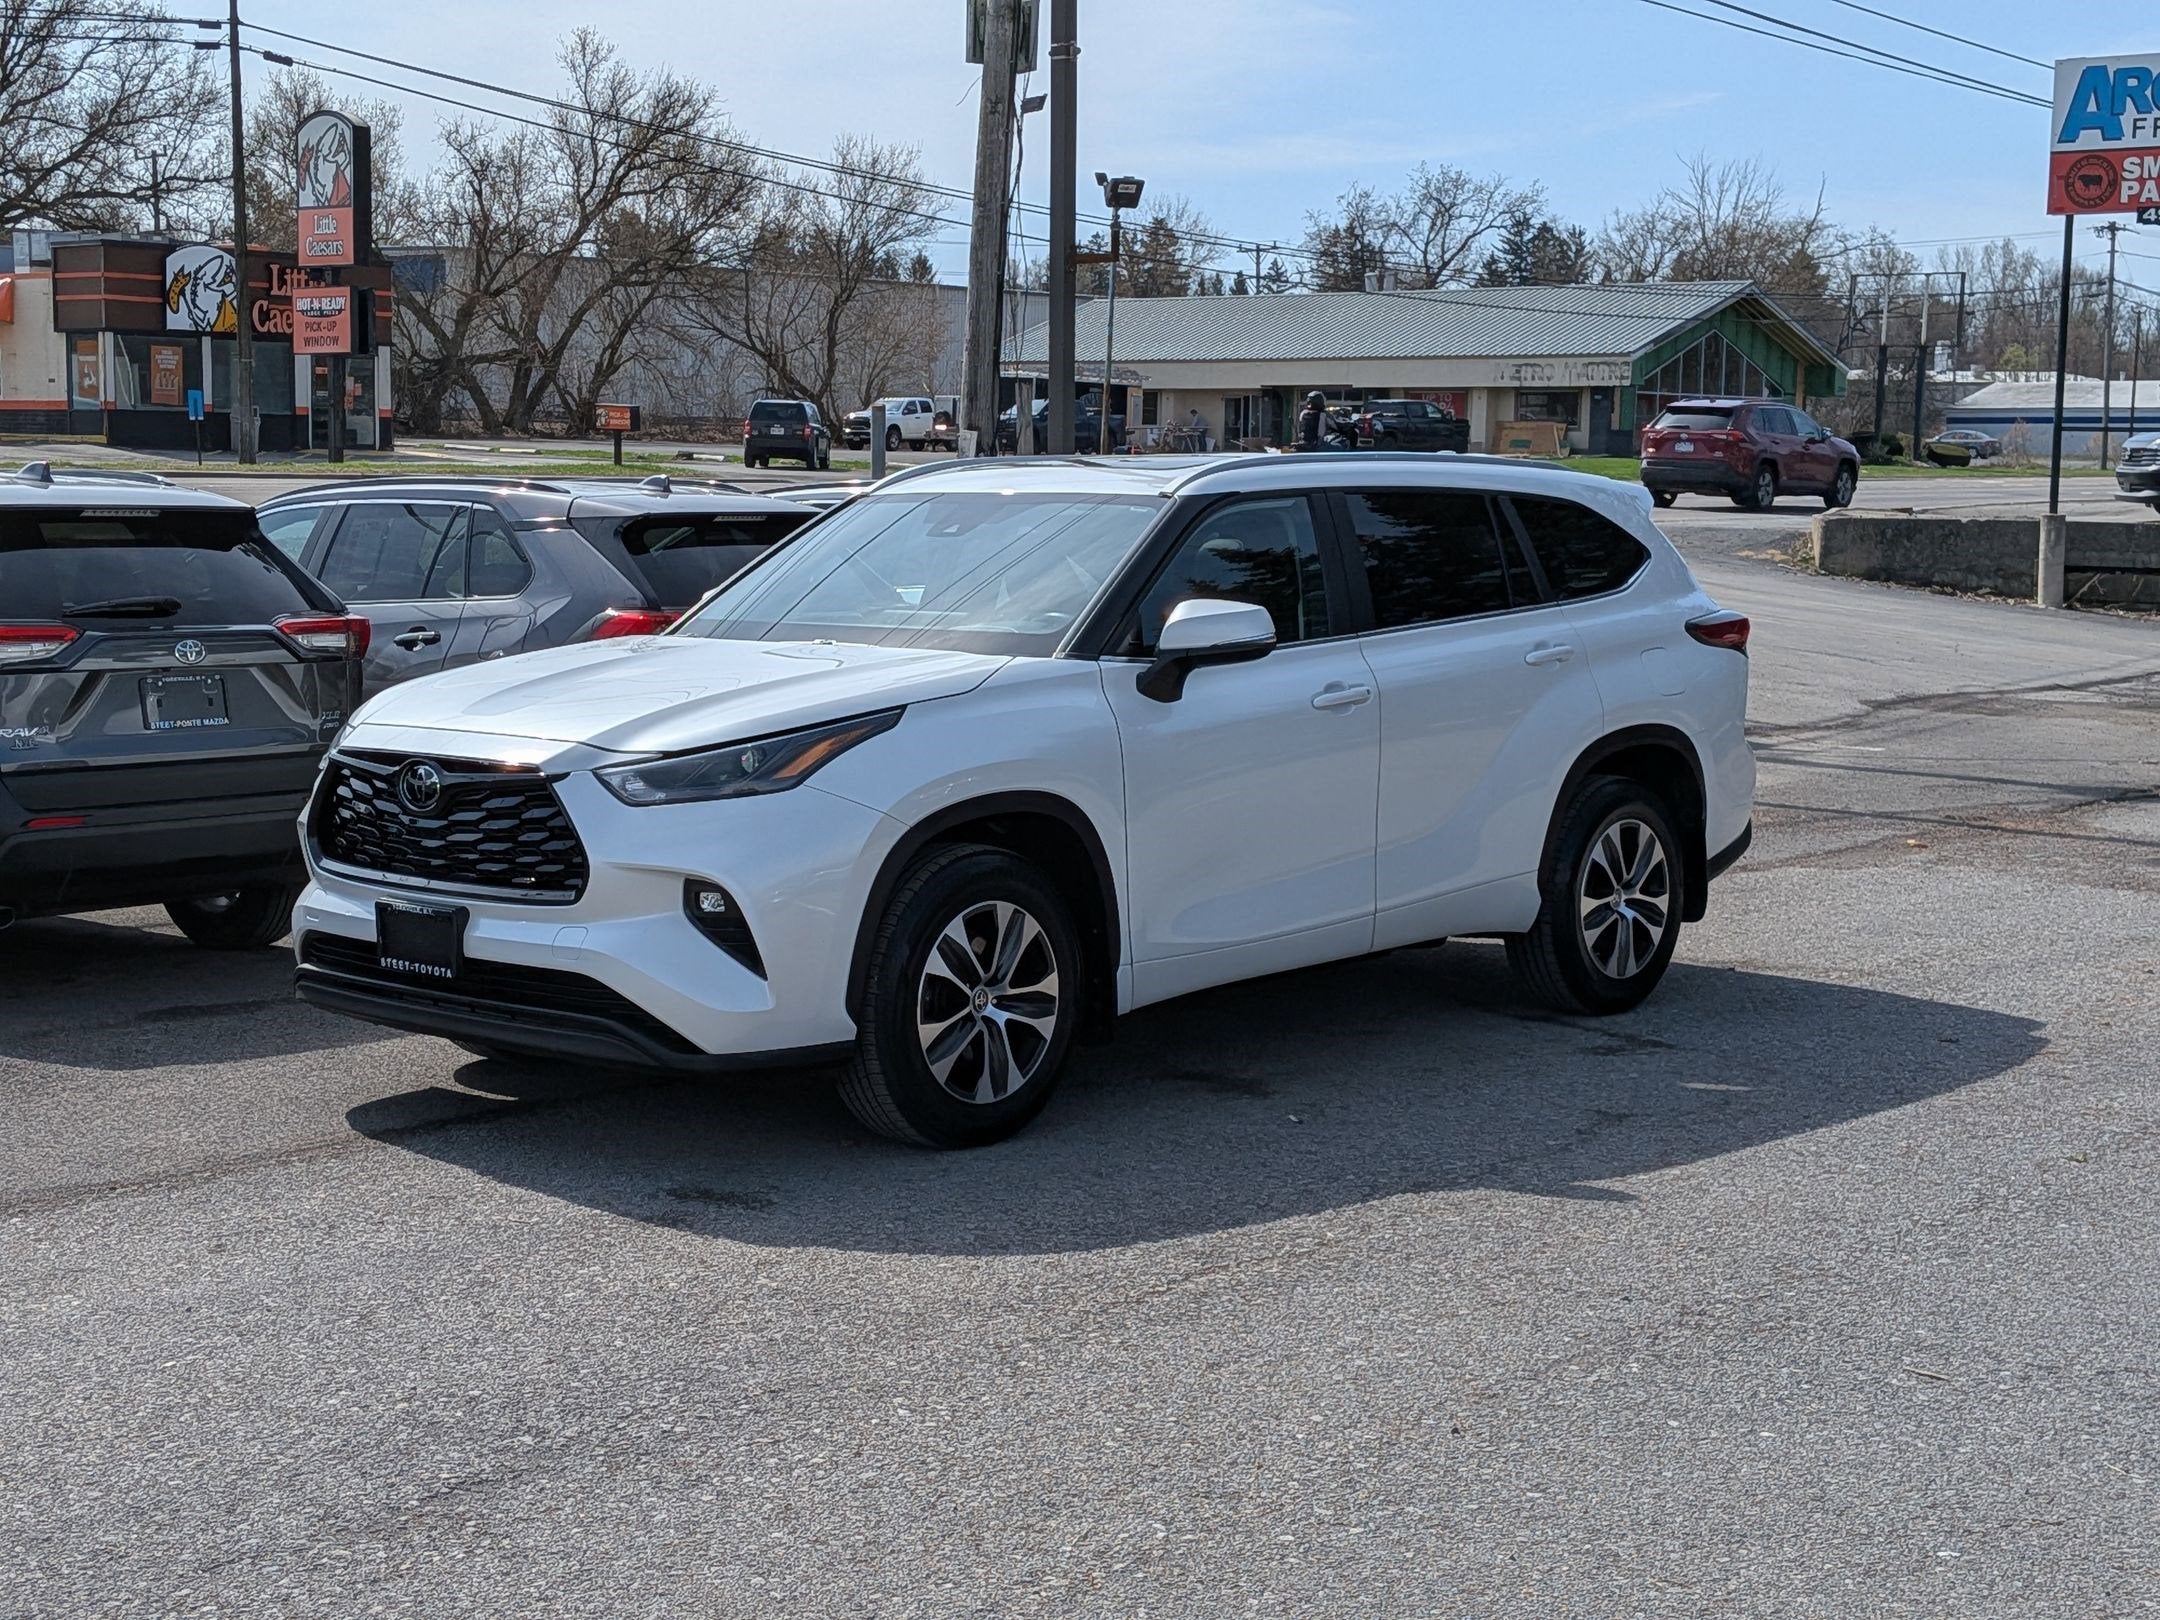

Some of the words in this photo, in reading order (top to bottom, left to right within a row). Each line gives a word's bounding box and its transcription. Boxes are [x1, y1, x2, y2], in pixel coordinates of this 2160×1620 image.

[2057, 65, 2160, 144] AR
[2143, 208, 2160, 222] 4
[313, 213, 337, 234] Little
[306, 236, 343, 256] Caesars
[296, 297, 346, 310] HOT-N-READY
[304, 320, 337, 332] PICK-UP
[303, 336, 339, 347] WINDOW
[203, 717, 230, 726] MAZDA
[380, 957, 452, 979] STEET-TOYOTA
